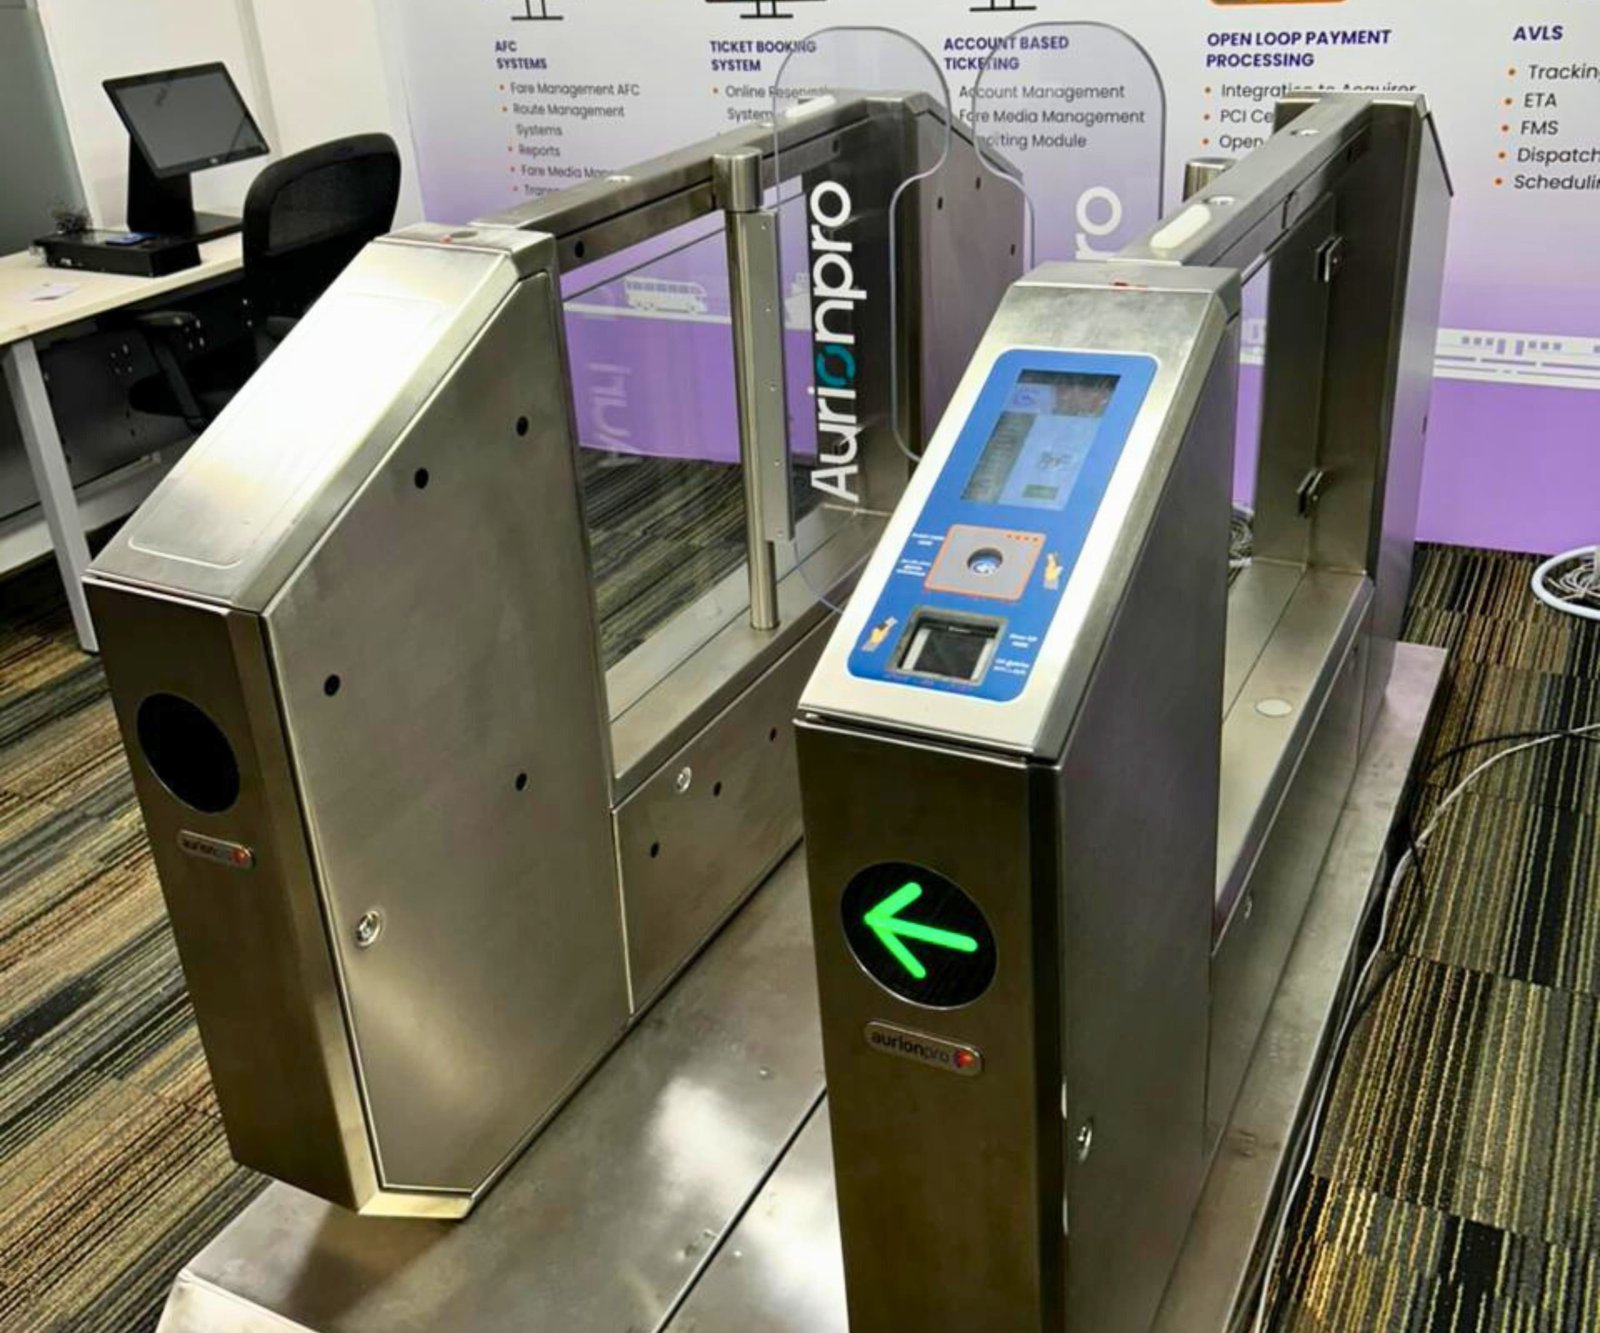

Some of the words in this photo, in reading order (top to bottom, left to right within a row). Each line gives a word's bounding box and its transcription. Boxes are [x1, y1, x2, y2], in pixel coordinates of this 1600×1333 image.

[1207, 32, 1251, 47] OPEN
[1256, 31, 1301, 46] LOOP
[1305, 29, 1392, 45] PAYMENT
[1513, 25, 1564, 41] AVLS
[495, 40, 518, 52] AFC
[710, 41, 754, 53] TICKET
[756, 40, 817, 53] BOOKING
[944, 37, 1016, 50] ACCOUNT
[1020, 36, 1069, 50] BASED
[496, 57, 548, 70] SYSTEMS
[711, 59, 761, 72] SYSTEM
[1206, 53, 1315, 68] PROCESSING
[1528, 63, 1600, 82] Trackin
[510, 82, 535, 95] Fare
[538, 83, 615, 98] Management
[617, 84, 640, 96] AFC
[725, 85, 765, 98] Online
[959, 85, 1018, 99] Account
[1022, 86, 1125, 103] Management
[1524, 93, 1557, 108] ETA
[513, 103, 545, 116] Route
[548, 104, 625, 120] Management
[959, 110, 989, 123] Fare
[993, 110, 1038, 123] Media
[1042, 110, 1145, 127] Management
[1220, 109, 1246, 124] PCI
[516, 124, 563, 138] Systems
[1521, 120, 1559, 136] FMS
[1032, 135, 1087, 148] Module
[1219, 135, 1264, 152] Open
[518, 143, 561, 158] Reports
[1517, 147, 1600, 167] Dispatch
[521, 164, 545, 177] Fare
[547, 165, 582, 178] Media
[809, 180, 867, 503] Aurionpro
